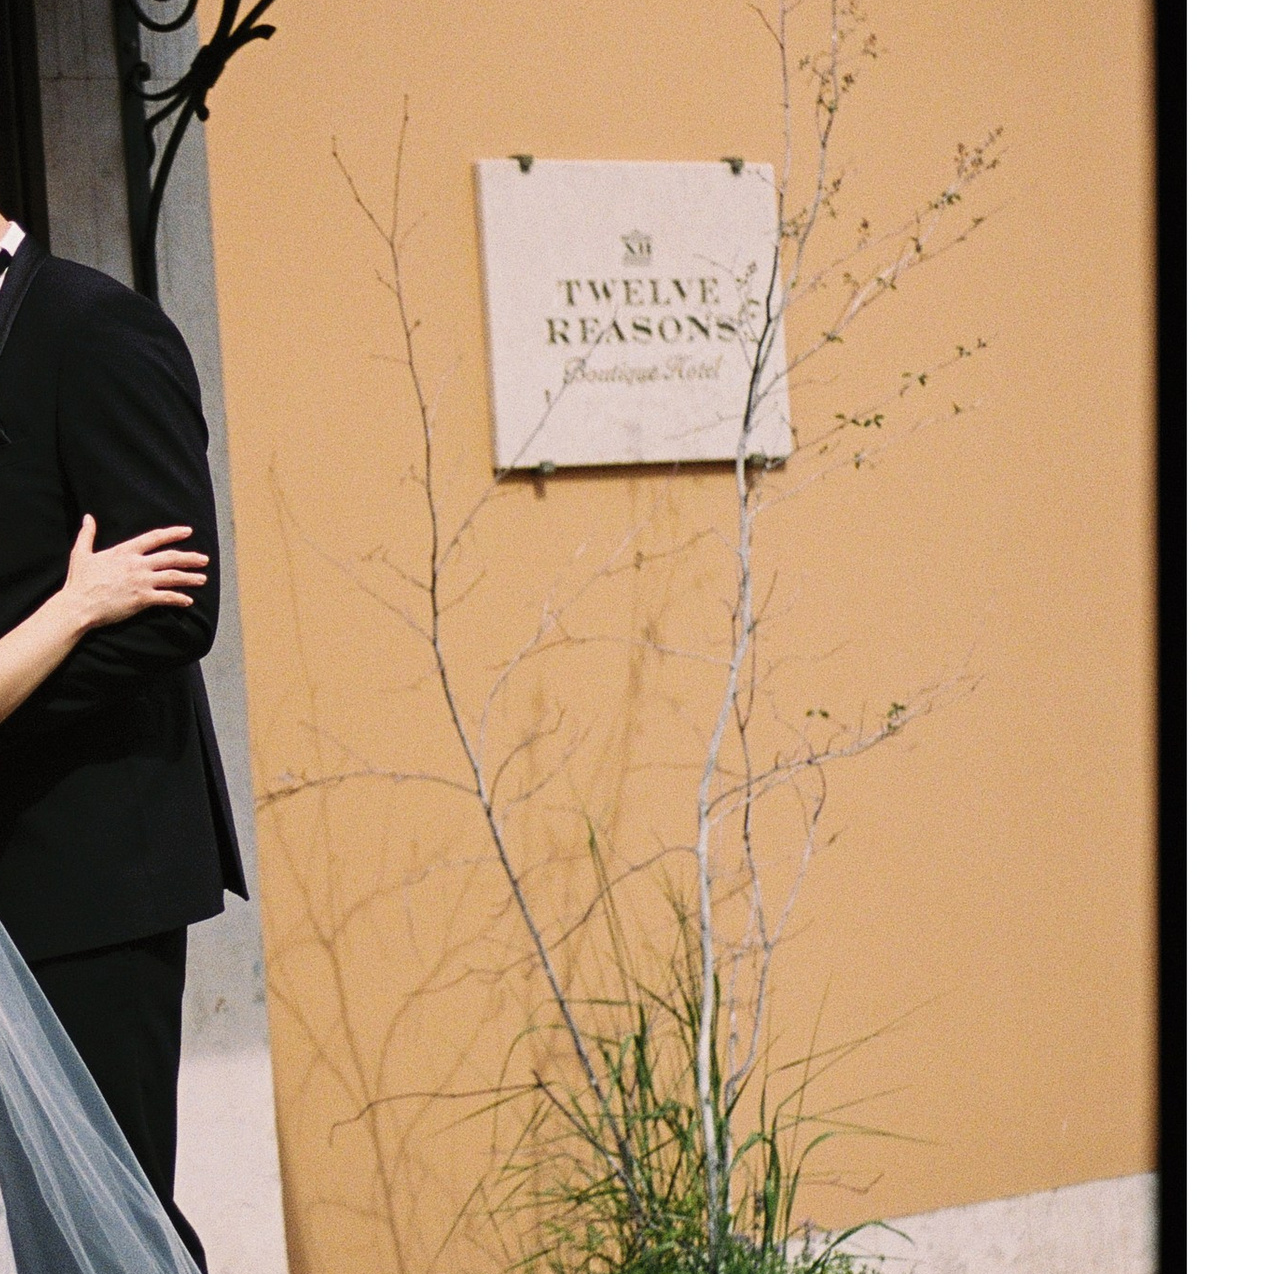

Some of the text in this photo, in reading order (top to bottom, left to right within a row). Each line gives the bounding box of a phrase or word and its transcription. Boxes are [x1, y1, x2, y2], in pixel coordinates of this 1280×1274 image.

[558, 278, 720, 307] TWELVE
[545, 315, 738, 345] REASONS
[663, 354, 724, 382] Hotel
